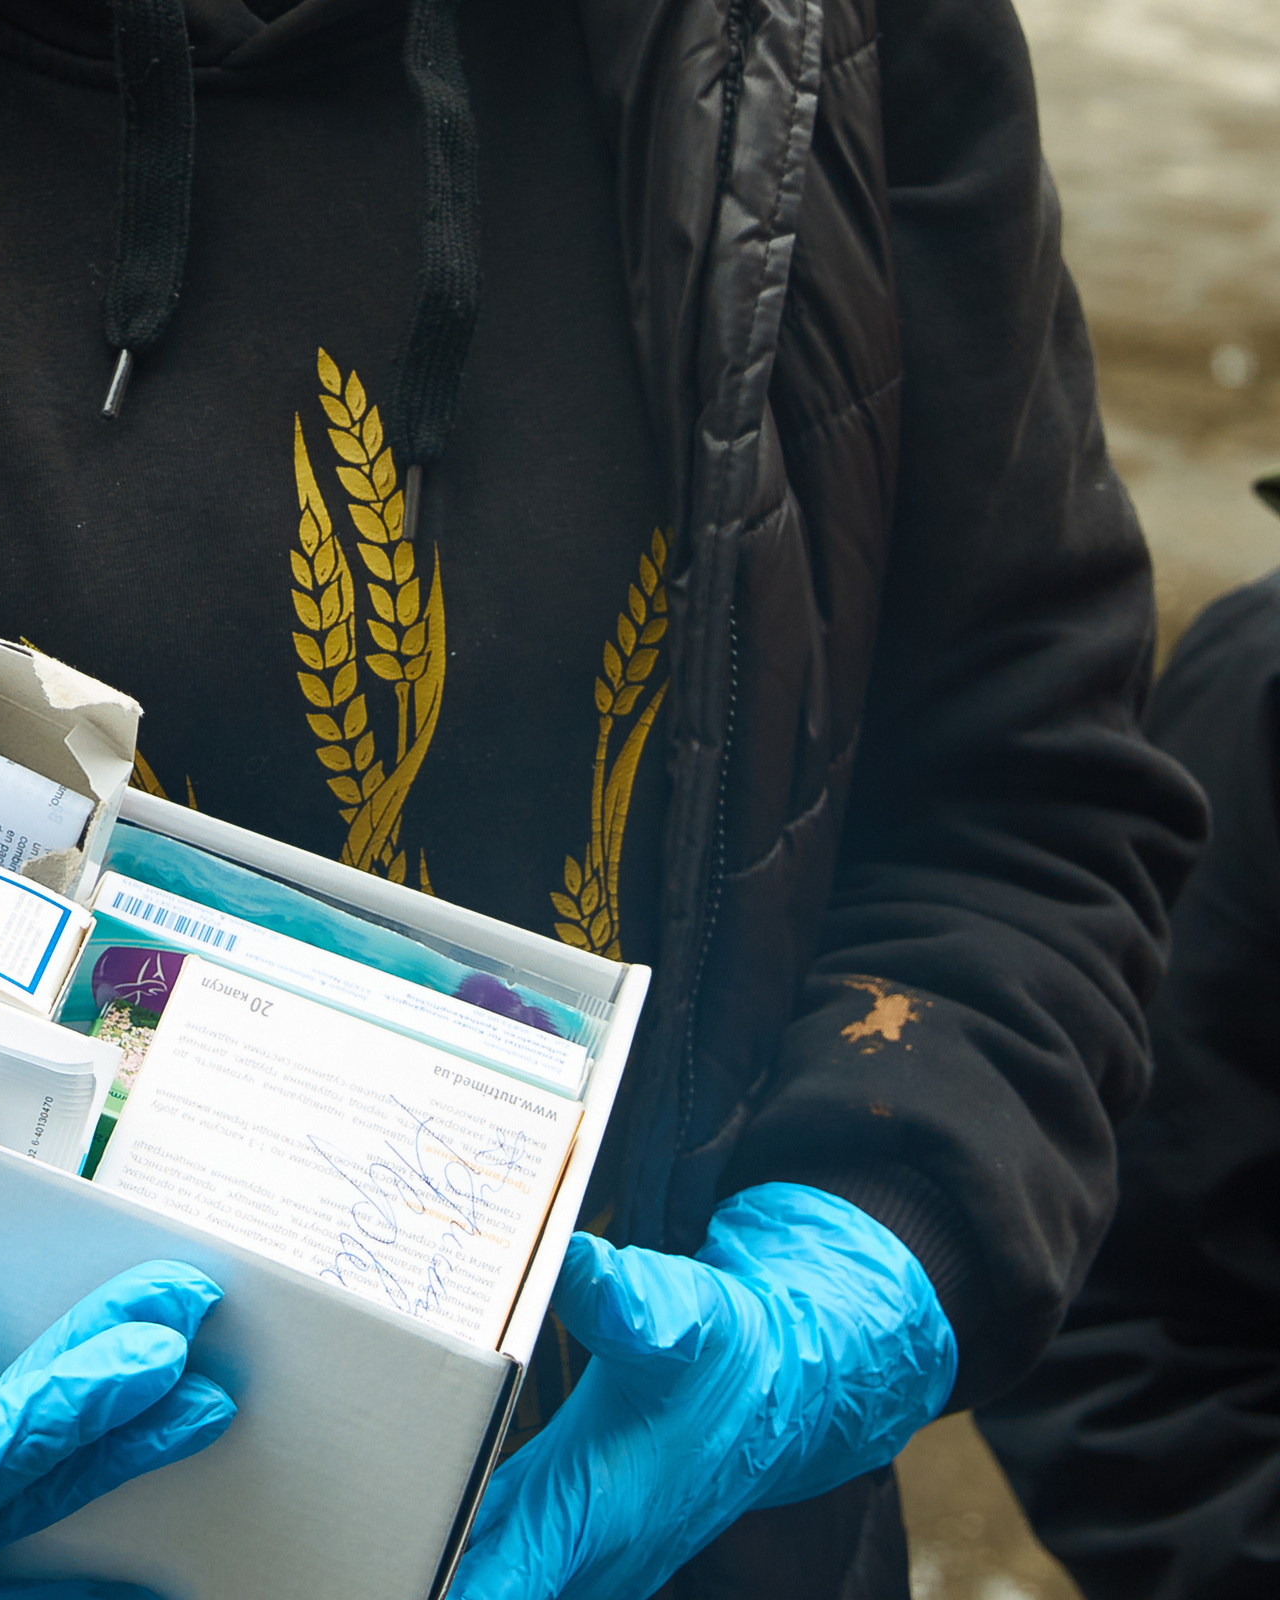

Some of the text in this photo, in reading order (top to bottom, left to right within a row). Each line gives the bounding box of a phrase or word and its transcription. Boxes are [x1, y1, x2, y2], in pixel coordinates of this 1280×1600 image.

[2, 828, 16, 844] en
[28, 841, 42, 856] un
[145, 886, 175, 902] GmbH
[175, 897, 215, 916] Johnson
[227, 917, 266, 935] Johnson
[244, 951, 275, 967] GmbH
[275, 963, 315, 981] Johnson
[309, 967, 341, 983] Neuss
[200, 973, 274, 1018] 20 капсул
[327, 982, 367, 1001] Johnson
[182, 1017, 239, 1047] надмірне
[383, 992, 565, 1065] Arzneimittel für Kinder unzugänglich
[171, 1045, 189, 1060] до
[176, 1030, 228, 1061] дитячий
[192, 1052, 257, 1086] чутливість
[154, 1085, 211, 1115] вживання
[260, 1079, 346, 1121] індивідуальна
[281, 1071, 344, 1103] годування
[430, 1063, 559, 1124] www.nutrimed.ua
[31, 1096, 54, 1146] 6-40130470
[148, 1097, 179, 1119] добу
[180, 1111, 196, 1123] на
[210, 1106, 250, 1130] Термін
[347, 1096, 389, 1120] період
[398, 1100, 486, 1142] захворювання
[197, 1115, 246, 1142] капсули
[250, 1122, 280, 1141] води
[349, 1114, 415, 1147] підвищена
[487, 1120, 548, 1151] вживання
[131, 1136, 208, 1176] концентрації
[247, 1137, 266, 1151] 1-3
[268, 1144, 286, 1158] по
[278, 1133, 334, 1163] кількістю
[287, 1151, 347, 1182] дорослим
[114, 1175, 158, 1201] сприяє
[176, 1186, 192, 1199] на
[209, 1166, 276, 1200] порушення
[347, 1175, 399, 1202] вживати
[192, 1191, 233, 1215] стресу
[224, 1188, 280, 1218] підвищує
[277, 1194, 333, 1223] викликає
[204, 1210, 288, 1252] оксидантному
[233, 1207, 299, 1241] щоденного
[335, 1217, 351, 1230] не
[373, 1216, 438, 1249] спричиняє
[484, 1214, 517, 1235] після
[291, 1246, 304, 1258] та
[300, 1234, 340, 1258] впливу
[437, 1244, 453, 1256] не
[453, 1250, 467, 1261] та
[307, 1254, 380, 1290] емоційному
[342, 1252, 416, 1289] негативного
[372, 1248, 424, 1275] загальне
[468, 1253, 503, 1275] уваги
